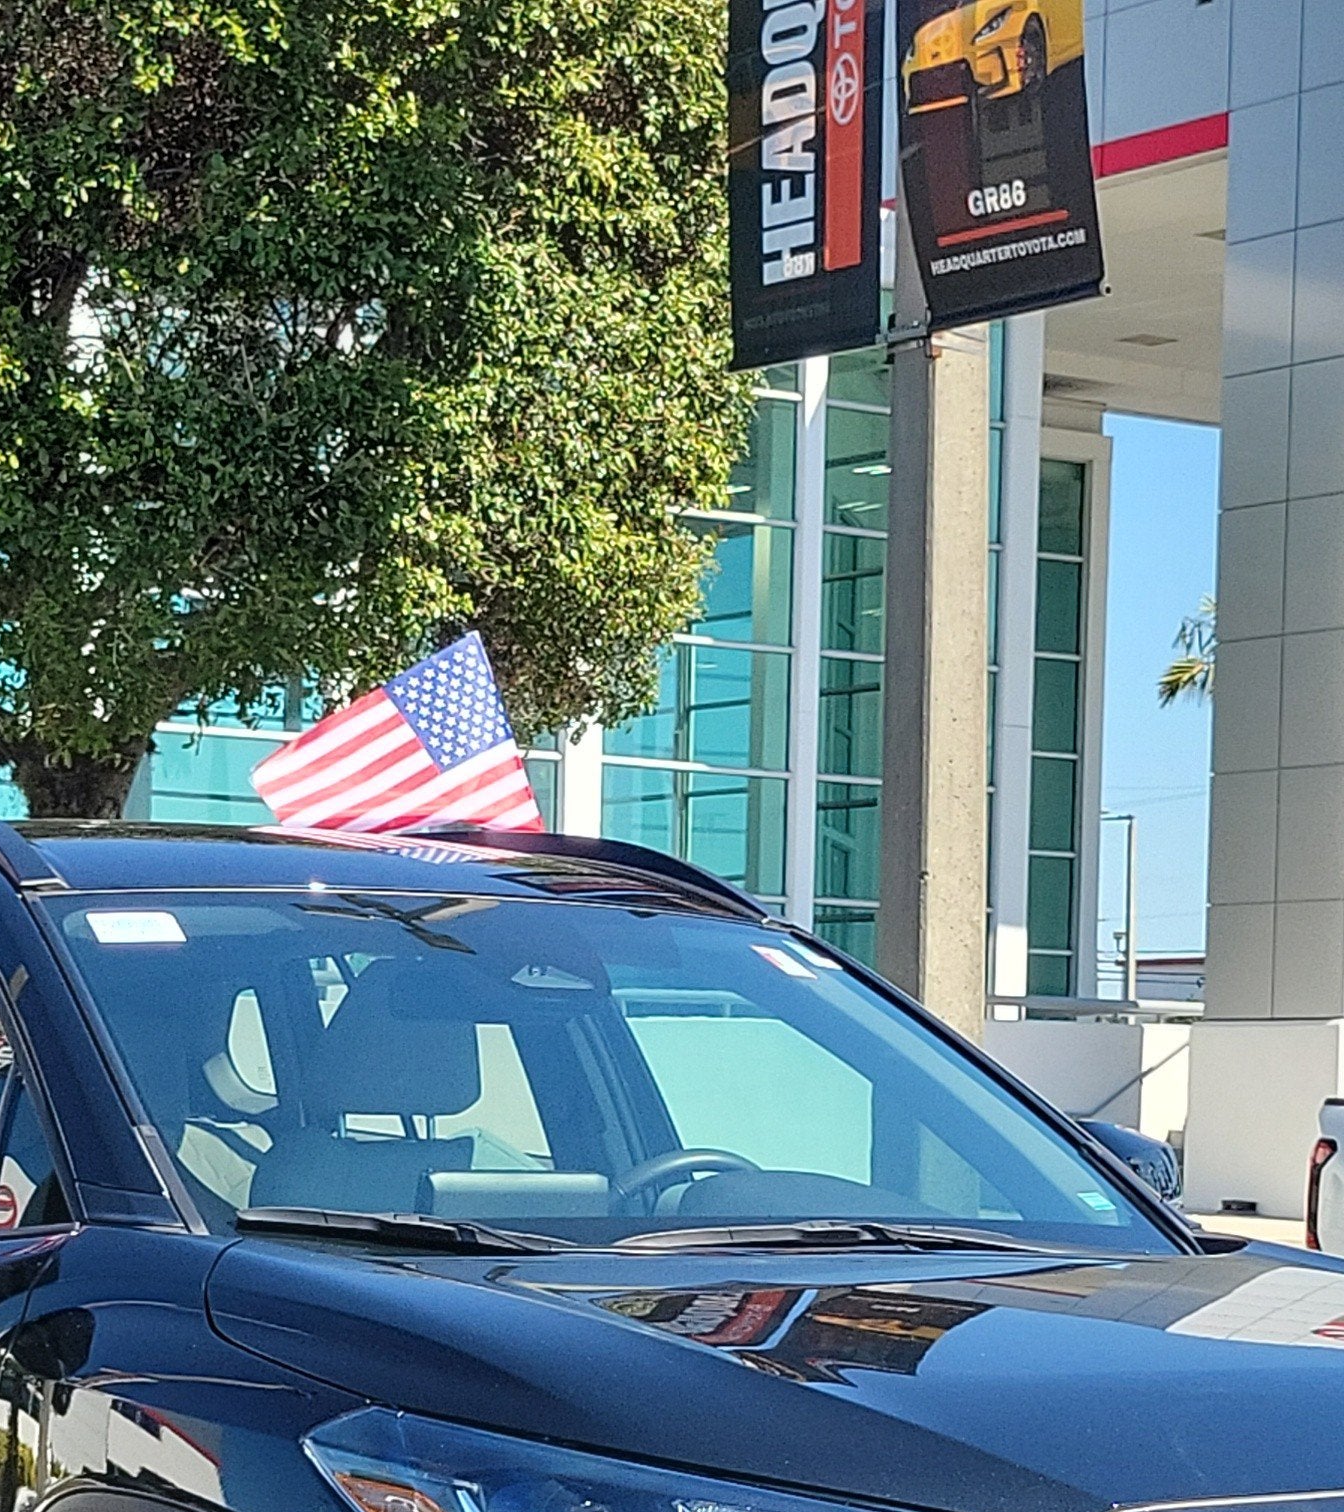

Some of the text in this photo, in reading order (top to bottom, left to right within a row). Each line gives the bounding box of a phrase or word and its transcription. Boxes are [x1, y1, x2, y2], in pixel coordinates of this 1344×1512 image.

[761, 0, 826, 286] HEADQ
[967, 179, 1026, 217] GR86
[930, 228, 1087, 276] HEADQUARTERTOYOTA.COM
